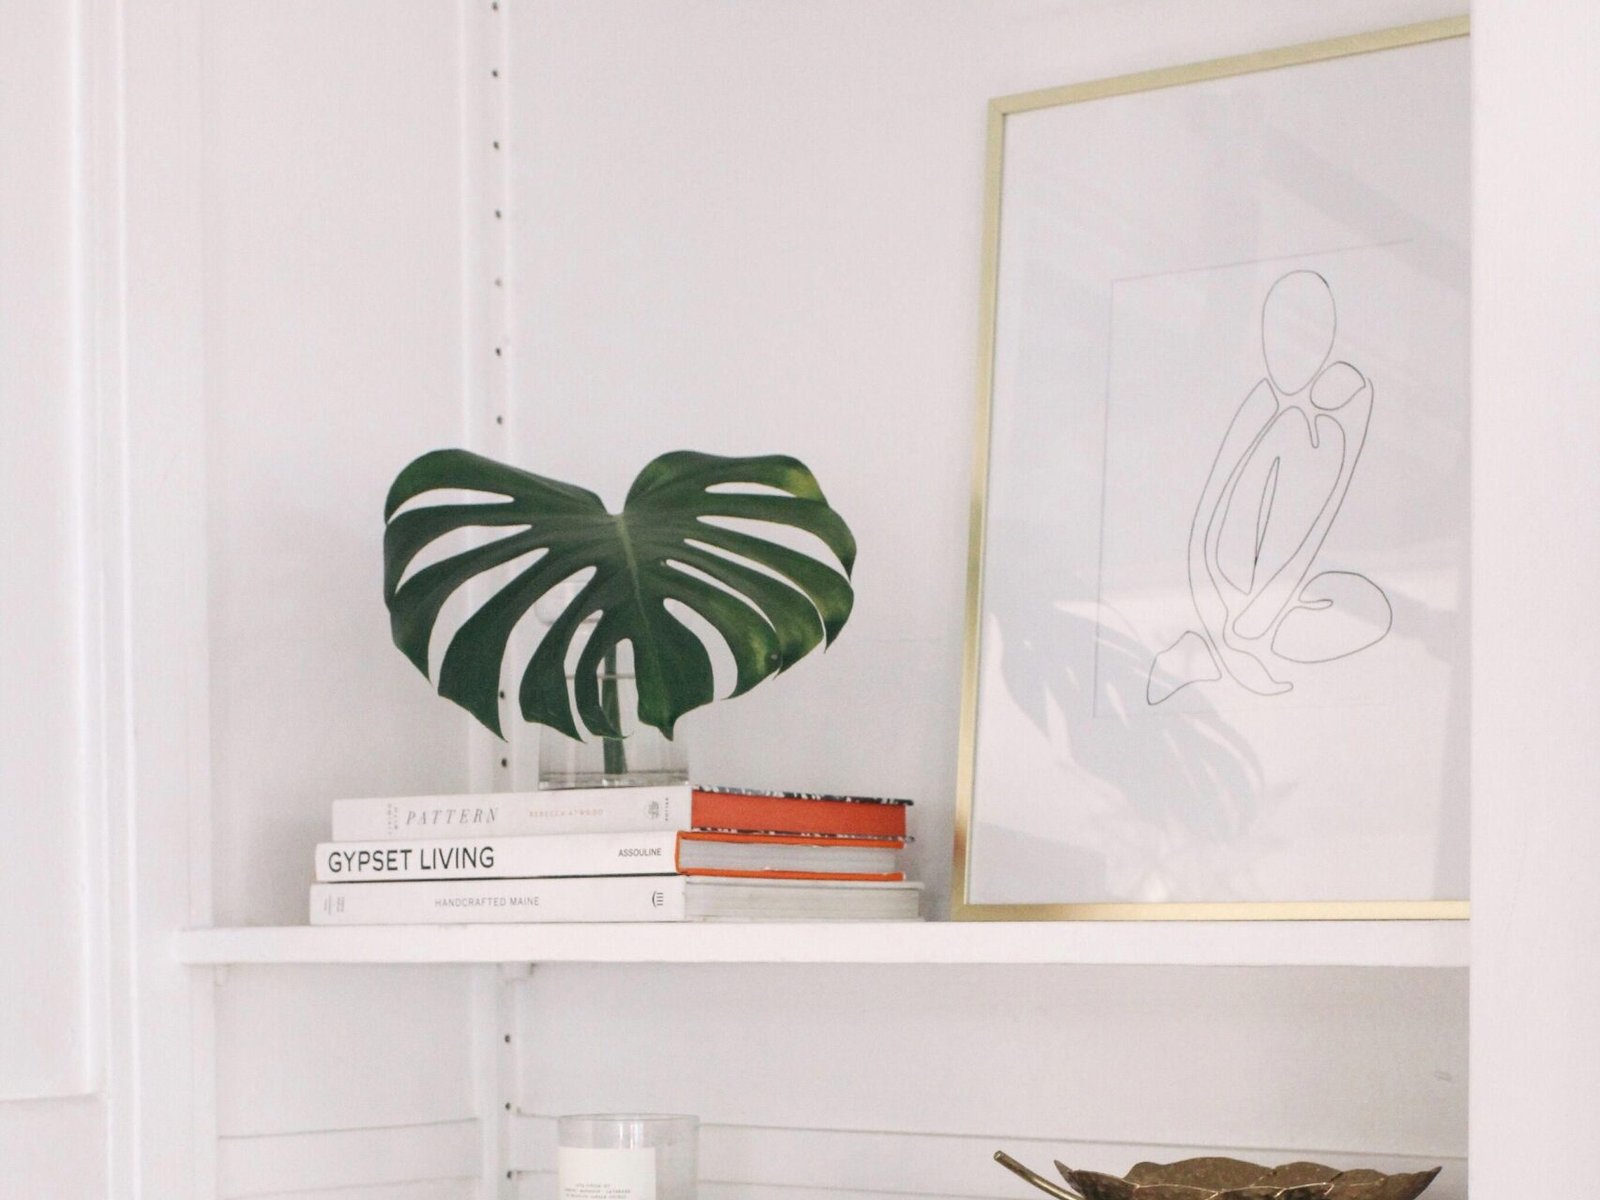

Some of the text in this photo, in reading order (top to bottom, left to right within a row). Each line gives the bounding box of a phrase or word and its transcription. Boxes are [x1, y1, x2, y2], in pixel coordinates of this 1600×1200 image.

[405, 807, 499, 826] PATTERN
[328, 846, 495, 873] GYPSET LIVING
[618, 847, 662, 858] ASSOULINE
[435, 896, 540, 908] HANDCRAFTED MAINE
